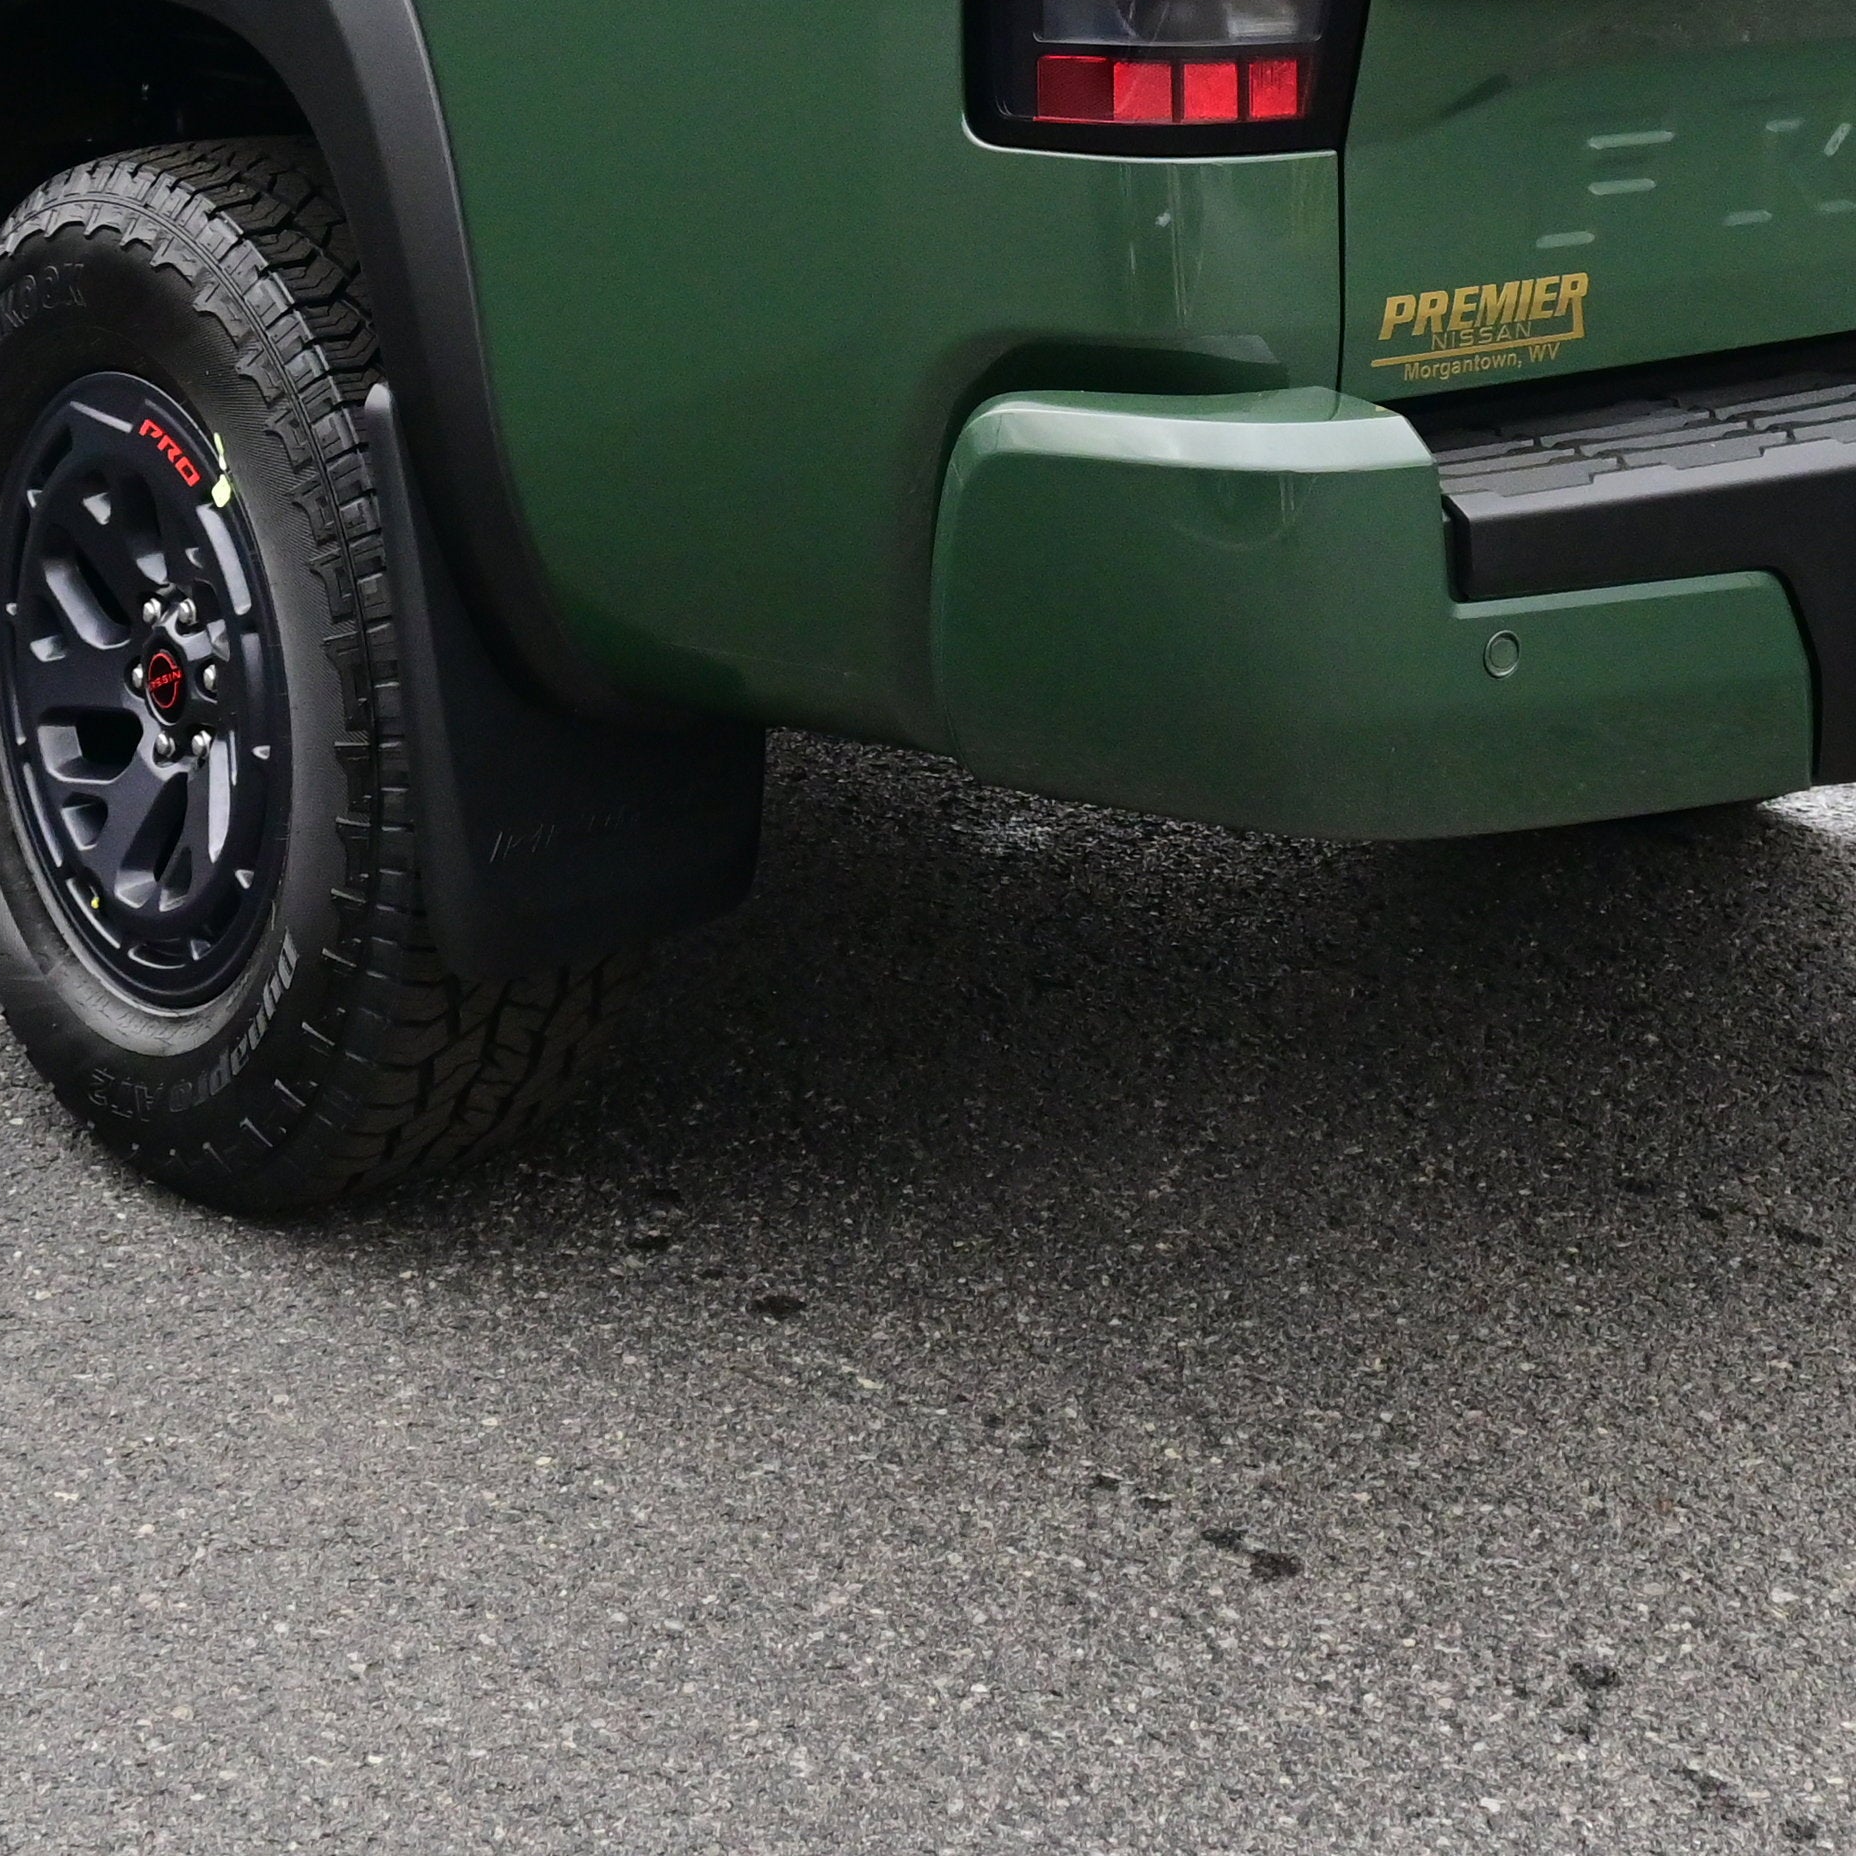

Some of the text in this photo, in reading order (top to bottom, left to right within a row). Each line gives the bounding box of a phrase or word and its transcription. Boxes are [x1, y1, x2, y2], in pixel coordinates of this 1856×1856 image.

[1378, 272, 1588, 340] PREMIER
[1404, 342, 1561, 382] Morgantown, WV
[1431, 321, 1532, 351] NISSAN
[139, 419, 201, 487] PRO
